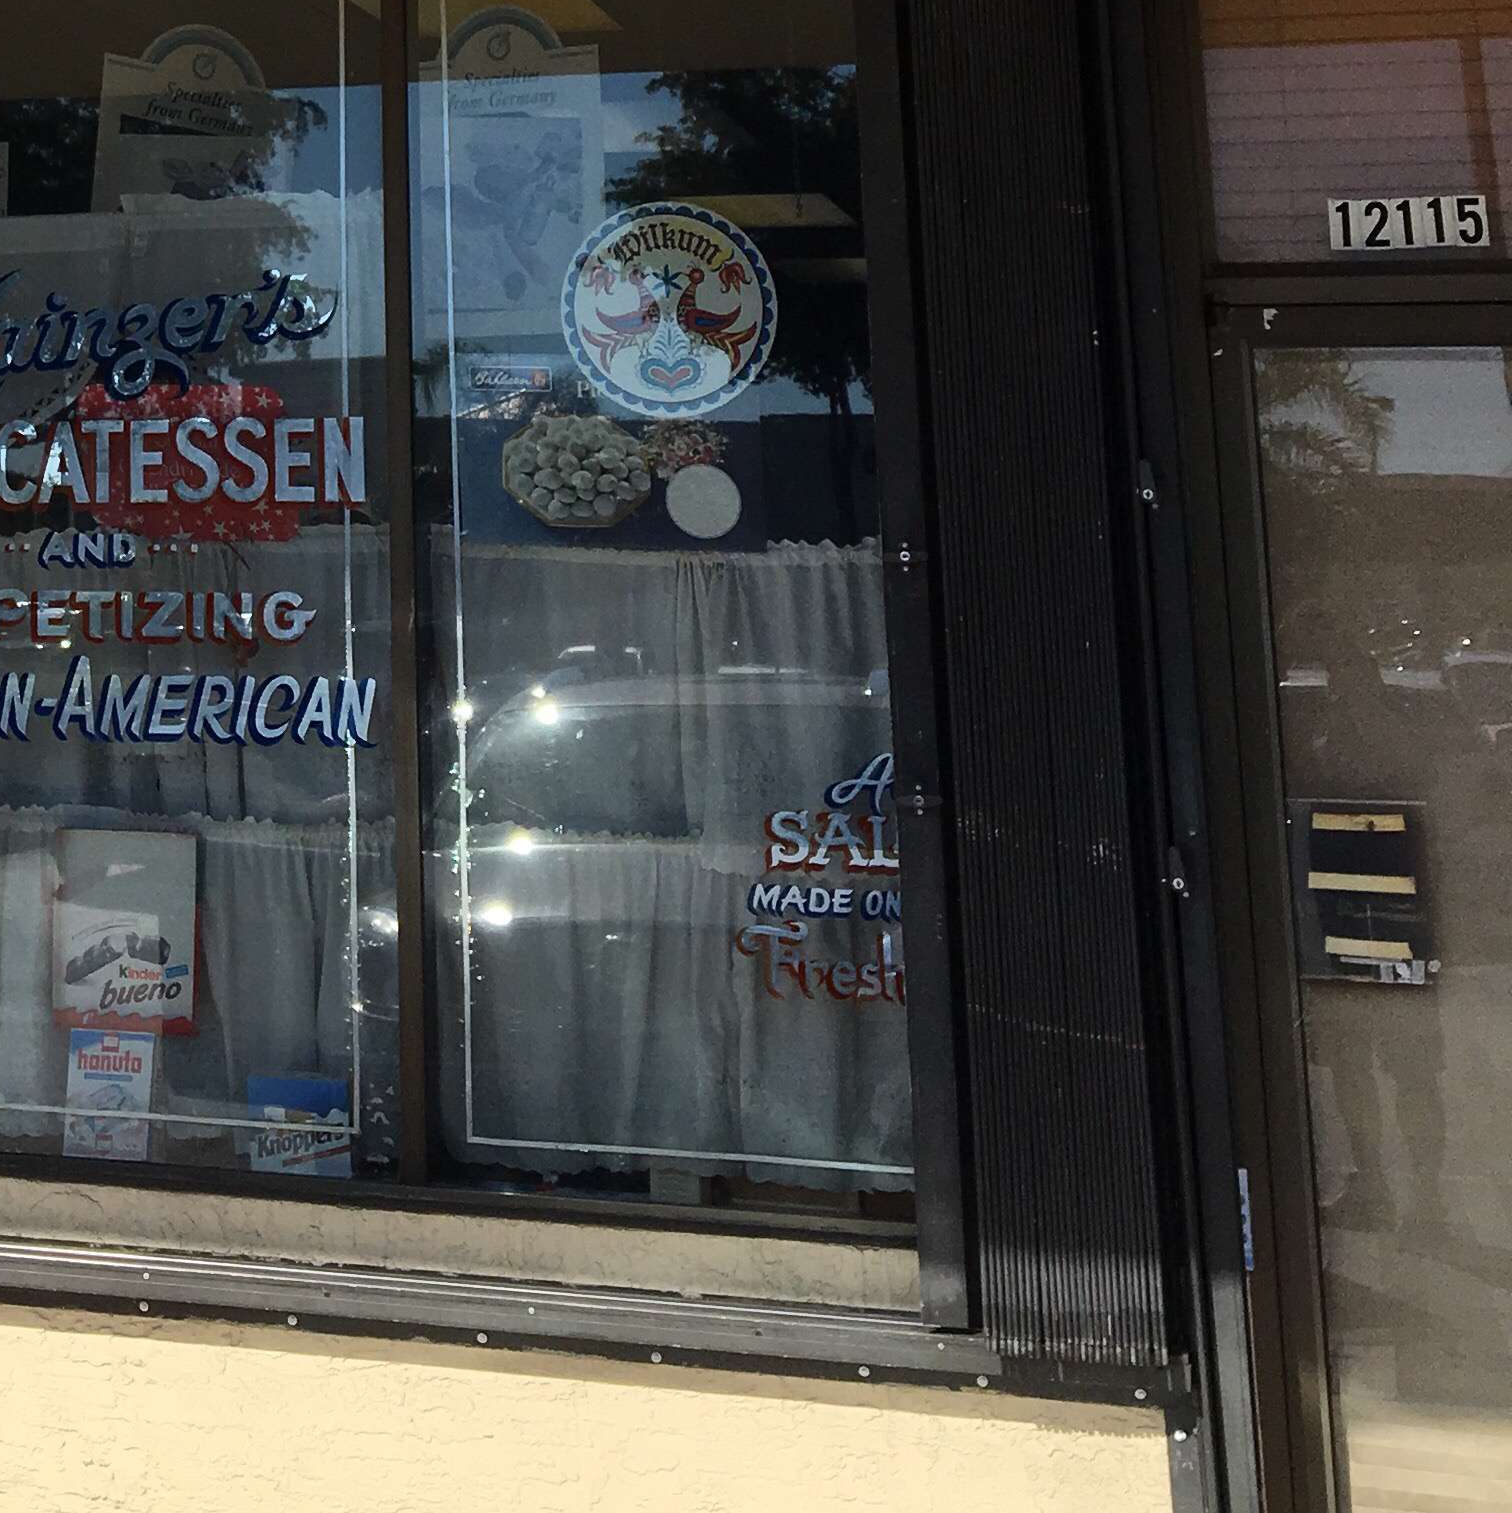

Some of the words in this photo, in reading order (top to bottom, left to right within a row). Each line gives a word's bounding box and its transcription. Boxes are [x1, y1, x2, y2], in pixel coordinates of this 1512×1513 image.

[1335, 197, 1484, 248] 12115
[38, 530, 137, 569] AND
[748, 883, 854, 920] MADE
[736, 920, 906, 1007] Fresh
[99, 978, 183, 1010] bueno
[78, 1048, 143, 1074] hanuta
